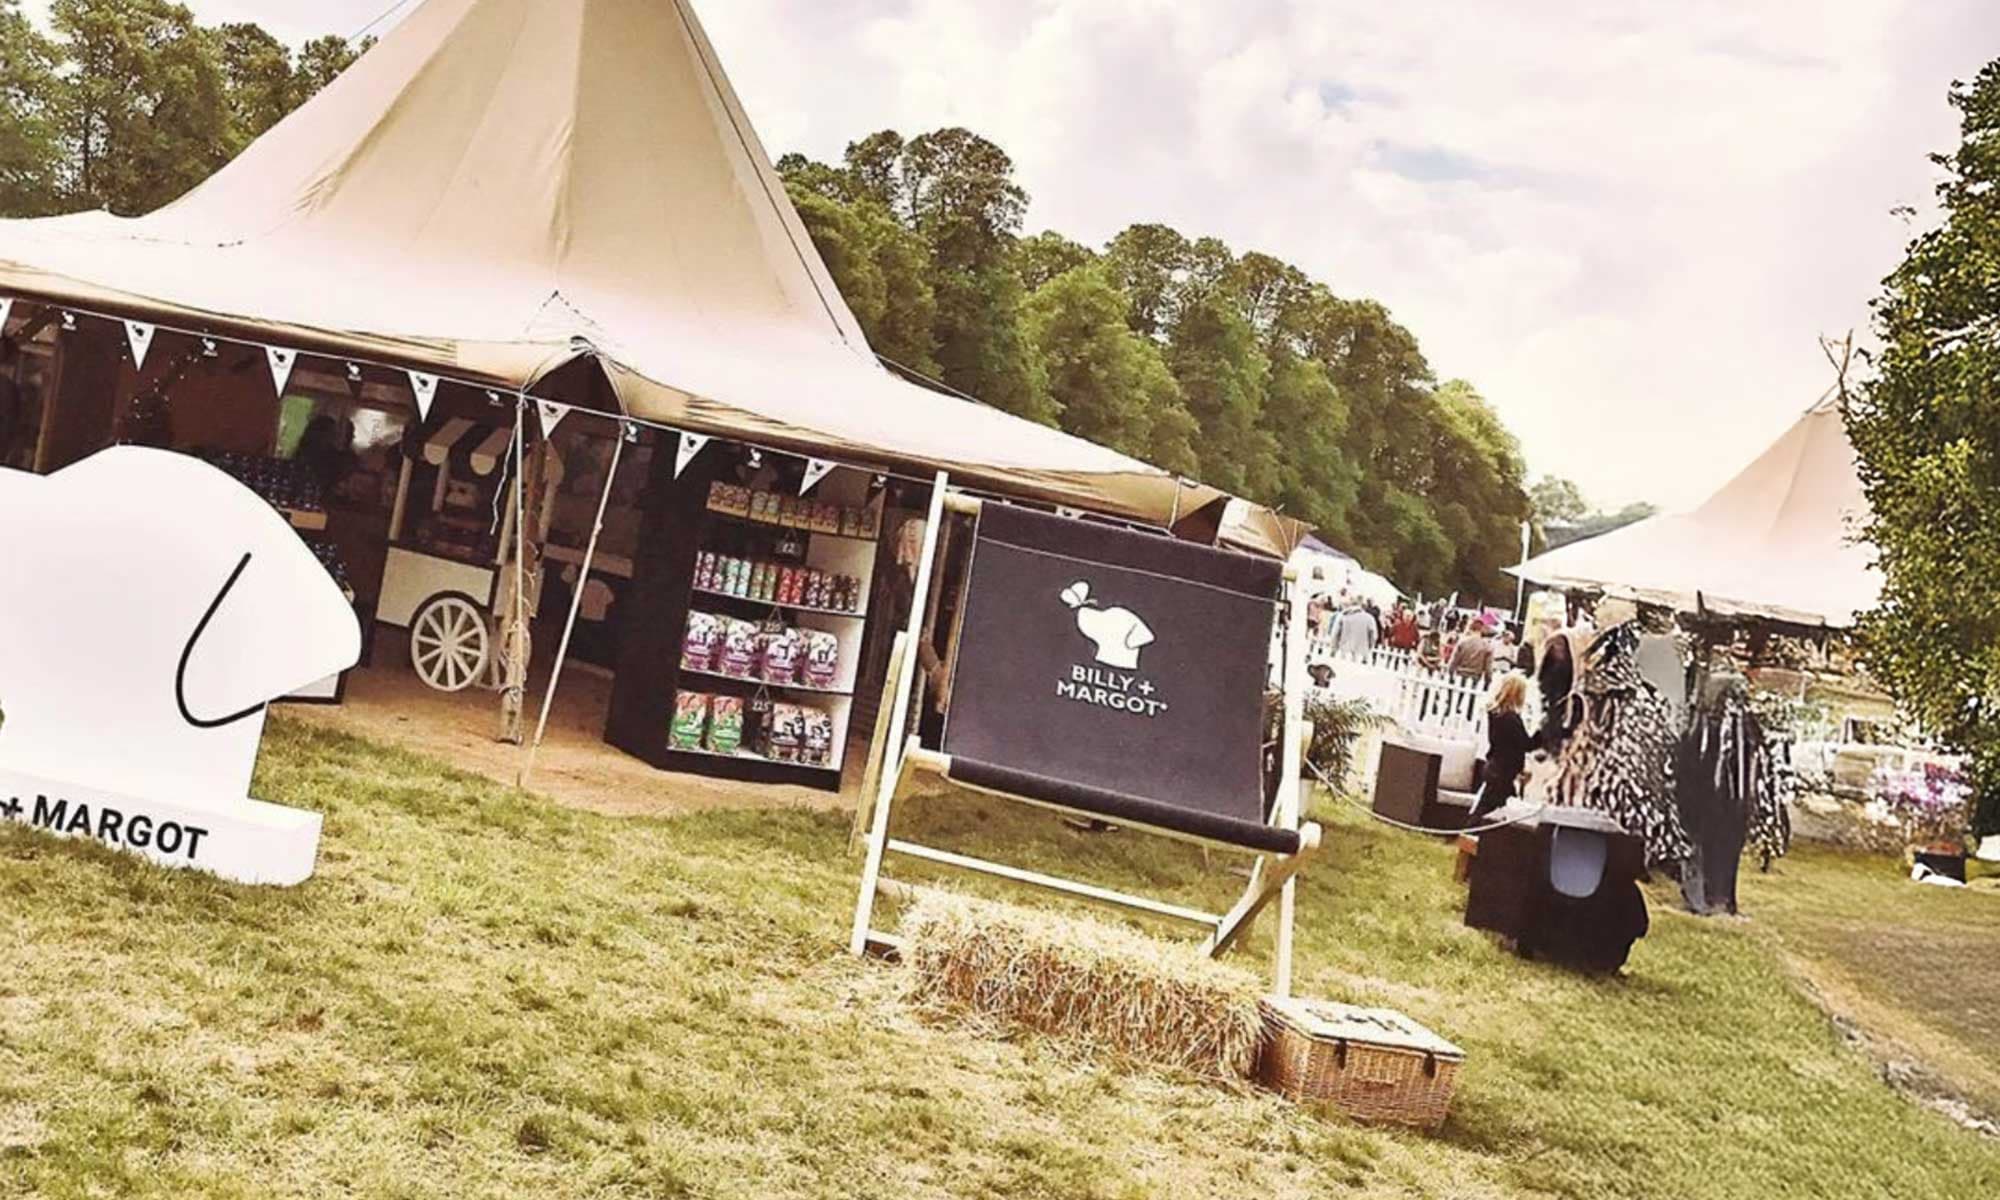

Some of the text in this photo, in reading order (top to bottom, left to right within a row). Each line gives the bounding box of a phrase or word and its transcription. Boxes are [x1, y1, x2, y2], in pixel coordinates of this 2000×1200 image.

[1072, 664, 1155, 696] BILLY +
[32, 795, 208, 859] MARGOT
